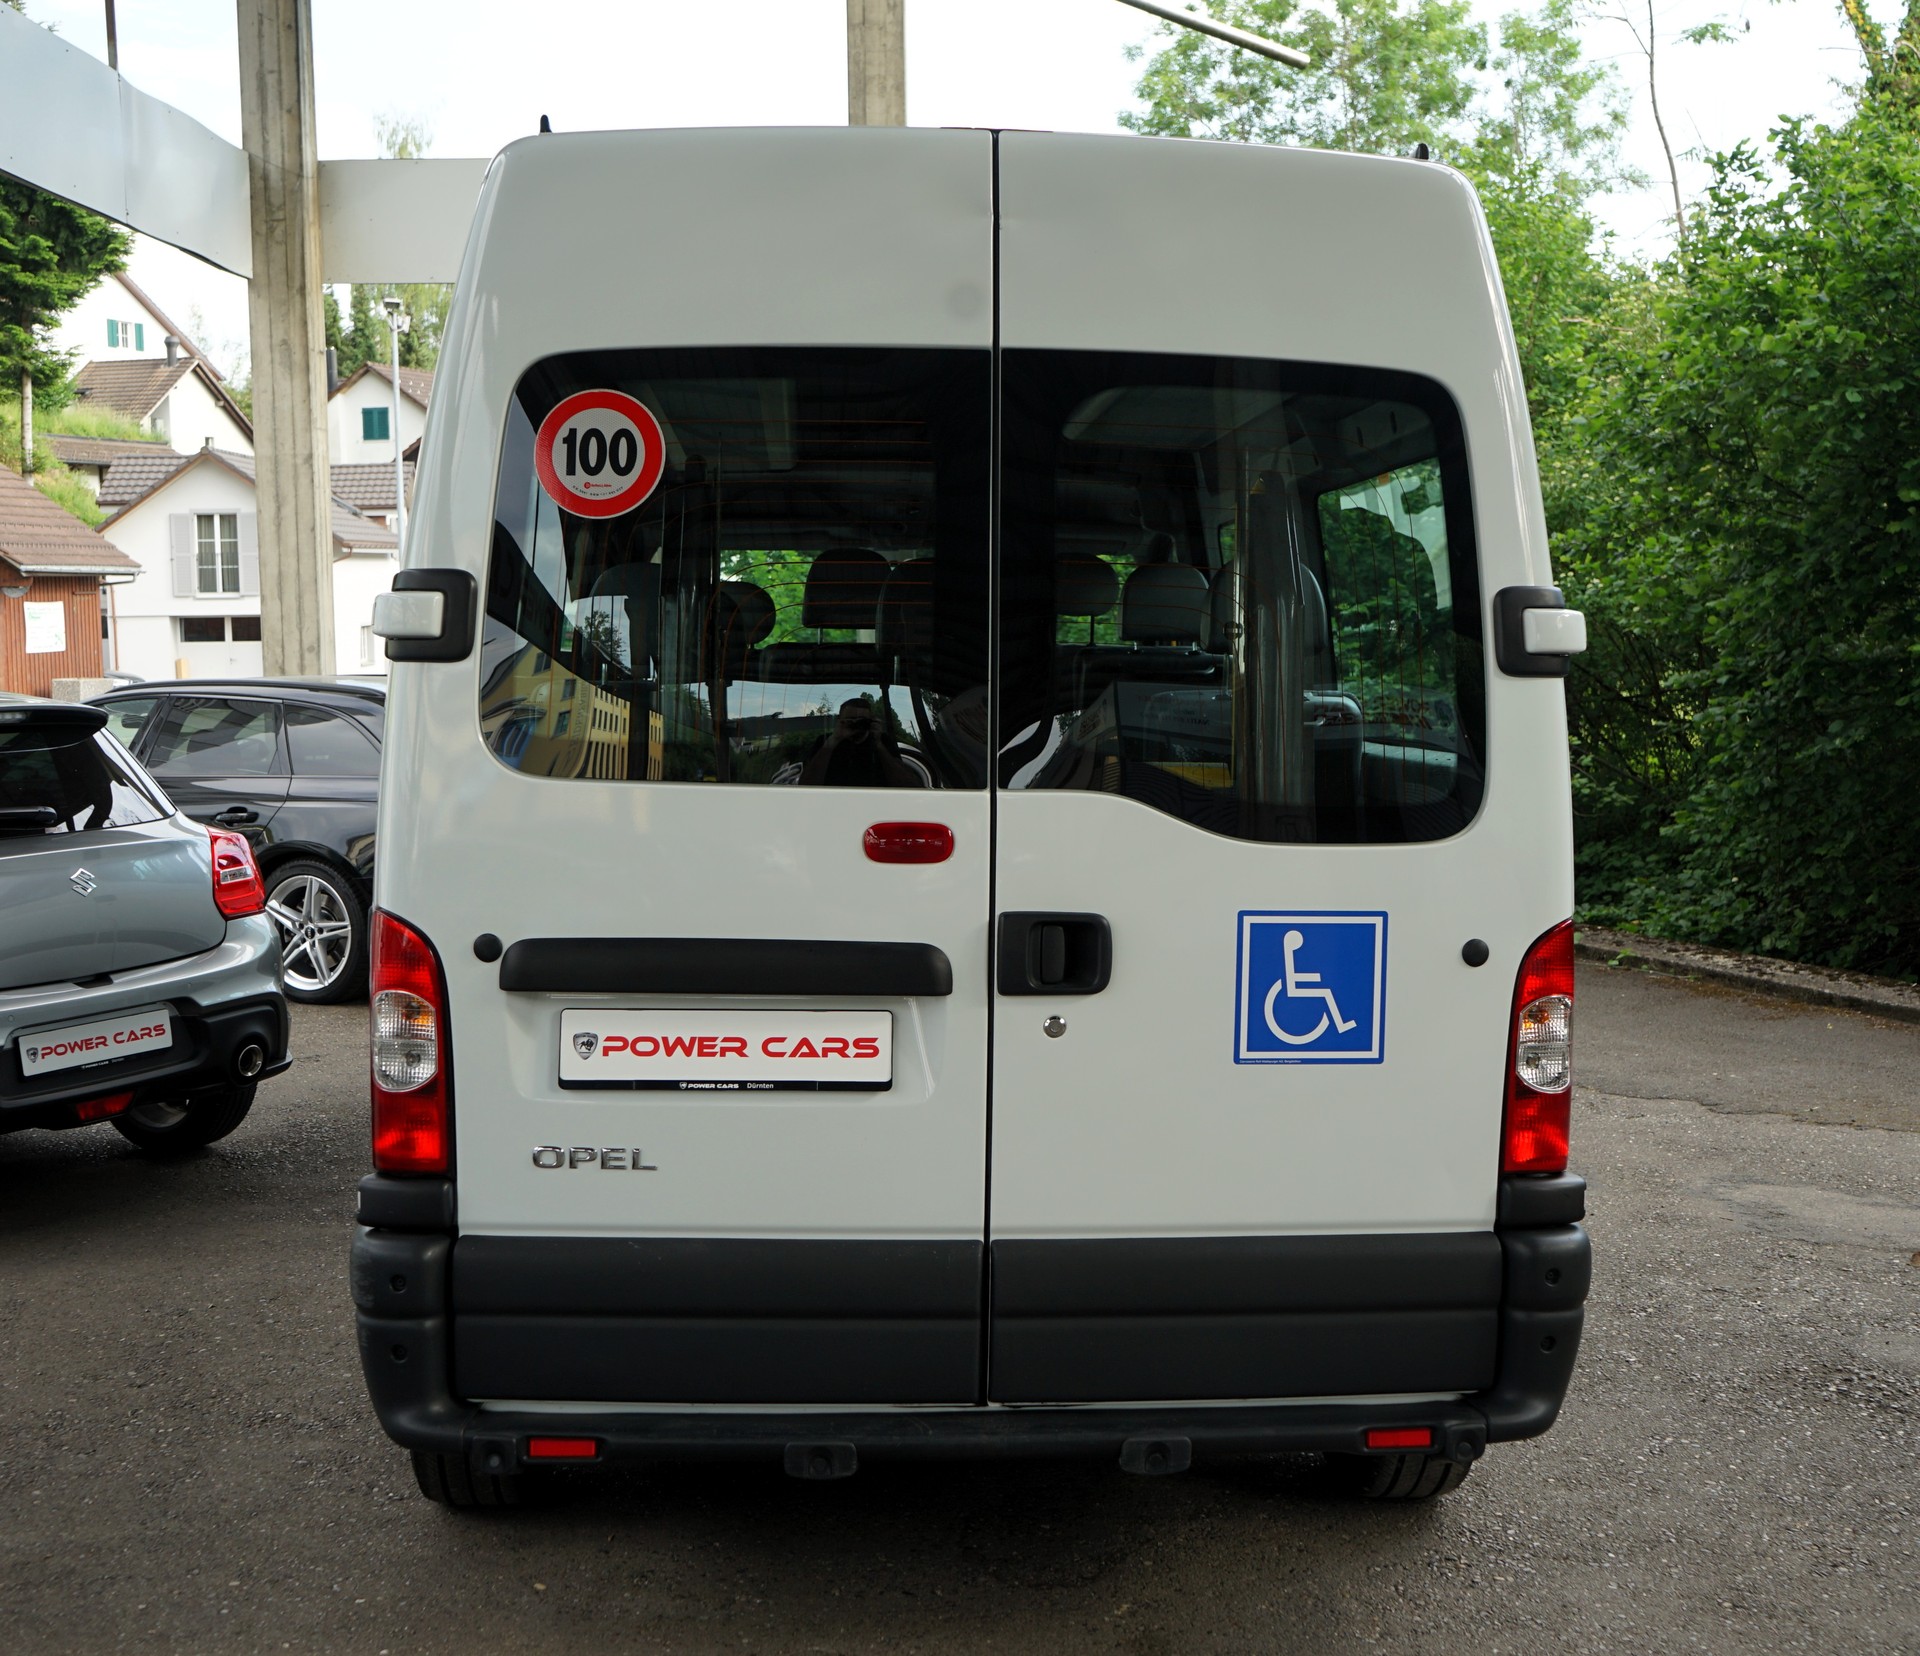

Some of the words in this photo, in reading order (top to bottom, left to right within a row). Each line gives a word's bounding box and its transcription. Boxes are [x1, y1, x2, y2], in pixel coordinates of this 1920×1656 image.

[562, 427, 638, 477] 100
[40, 1036, 109, 1060] POWER
[112, 1023, 167, 1045] CARS
[602, 1036, 749, 1058] POWER
[761, 1036, 880, 1059] CARS
[532, 1145, 658, 1171] OPEL
